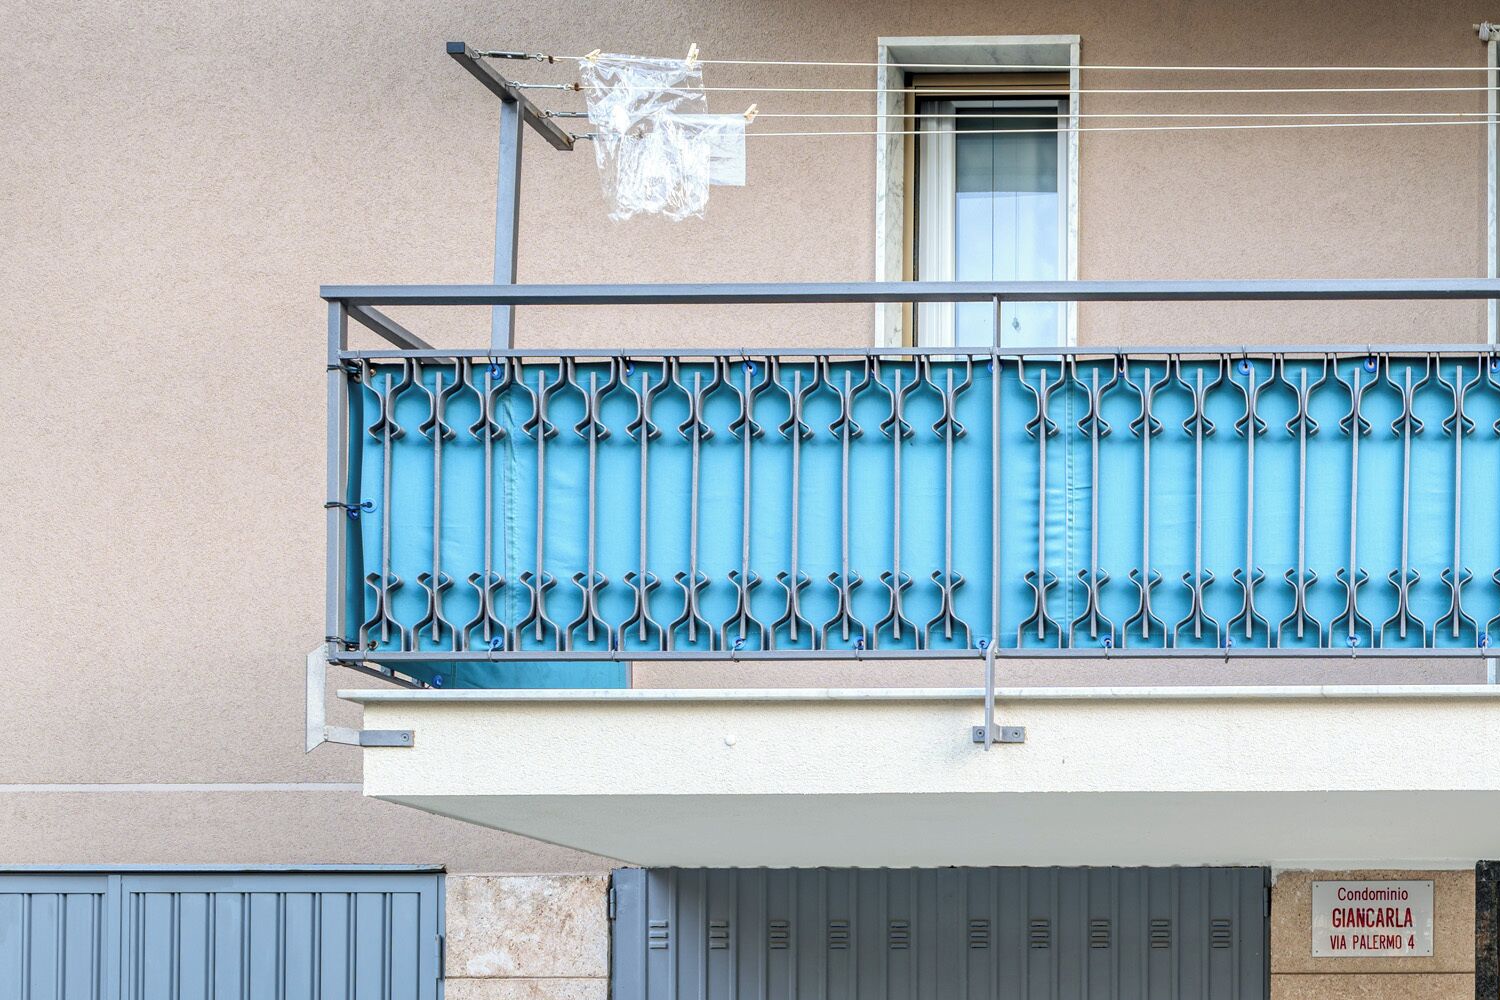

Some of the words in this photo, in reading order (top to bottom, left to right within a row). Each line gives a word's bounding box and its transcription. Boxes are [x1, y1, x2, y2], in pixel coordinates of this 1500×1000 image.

[1337, 887, 1409, 901] Condominio
[1332, 907, 1413, 928] GIANCARLA
[1330, 935, 1347, 950] VIA
[1352, 934, 1402, 950] PALERMO
[1408, 934, 1415, 950] 4
